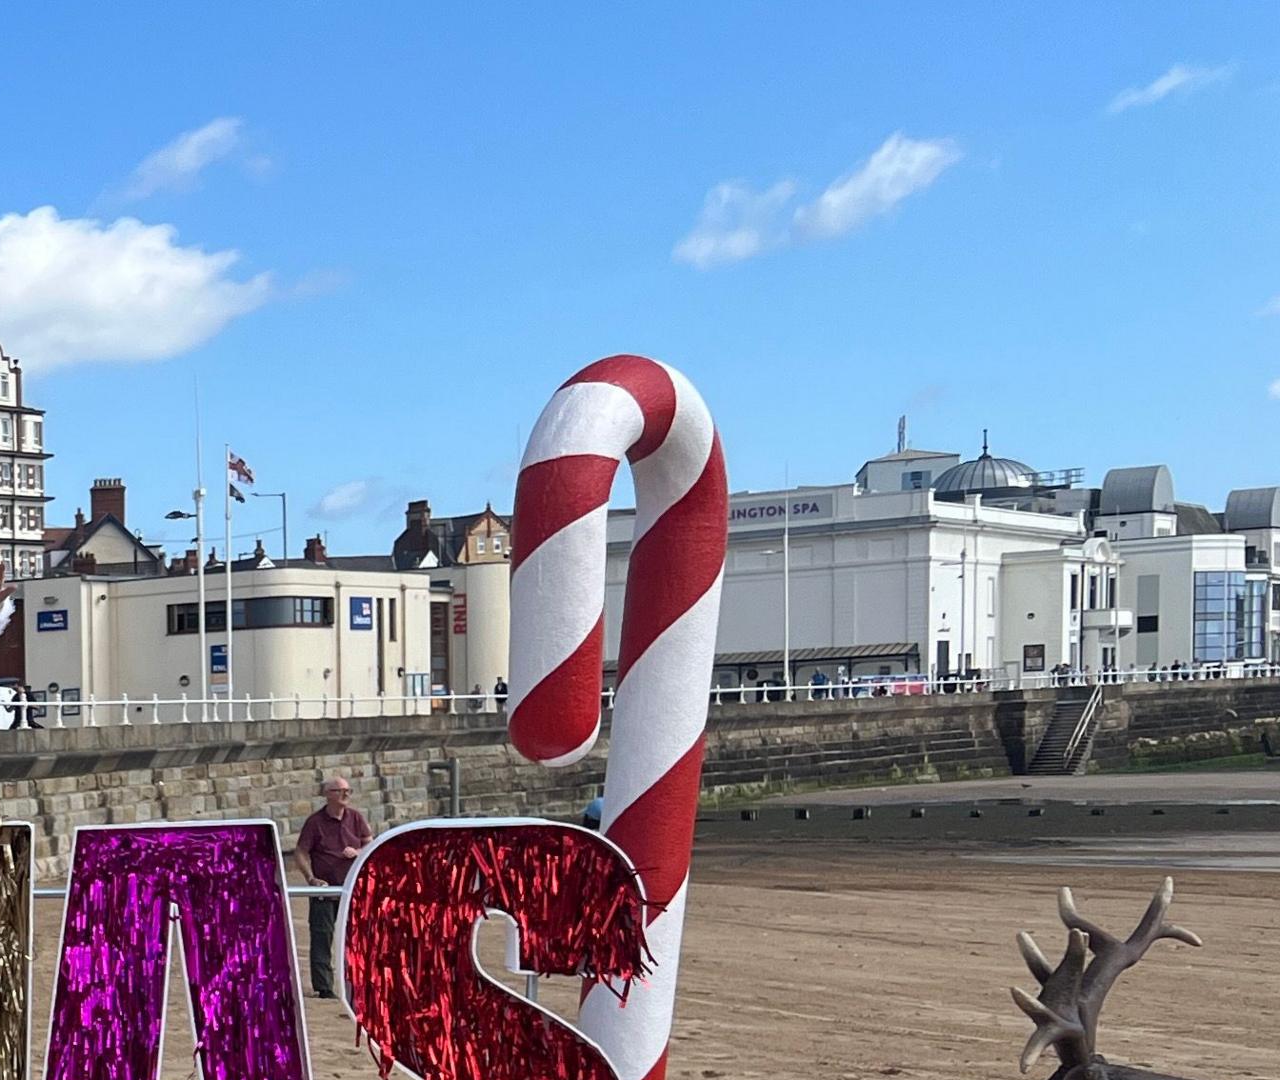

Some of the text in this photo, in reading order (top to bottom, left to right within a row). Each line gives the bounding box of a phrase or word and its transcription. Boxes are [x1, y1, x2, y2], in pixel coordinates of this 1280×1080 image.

[728, 502, 820, 520] INGTON SPA
[452, 592, 467, 635] RNLI
